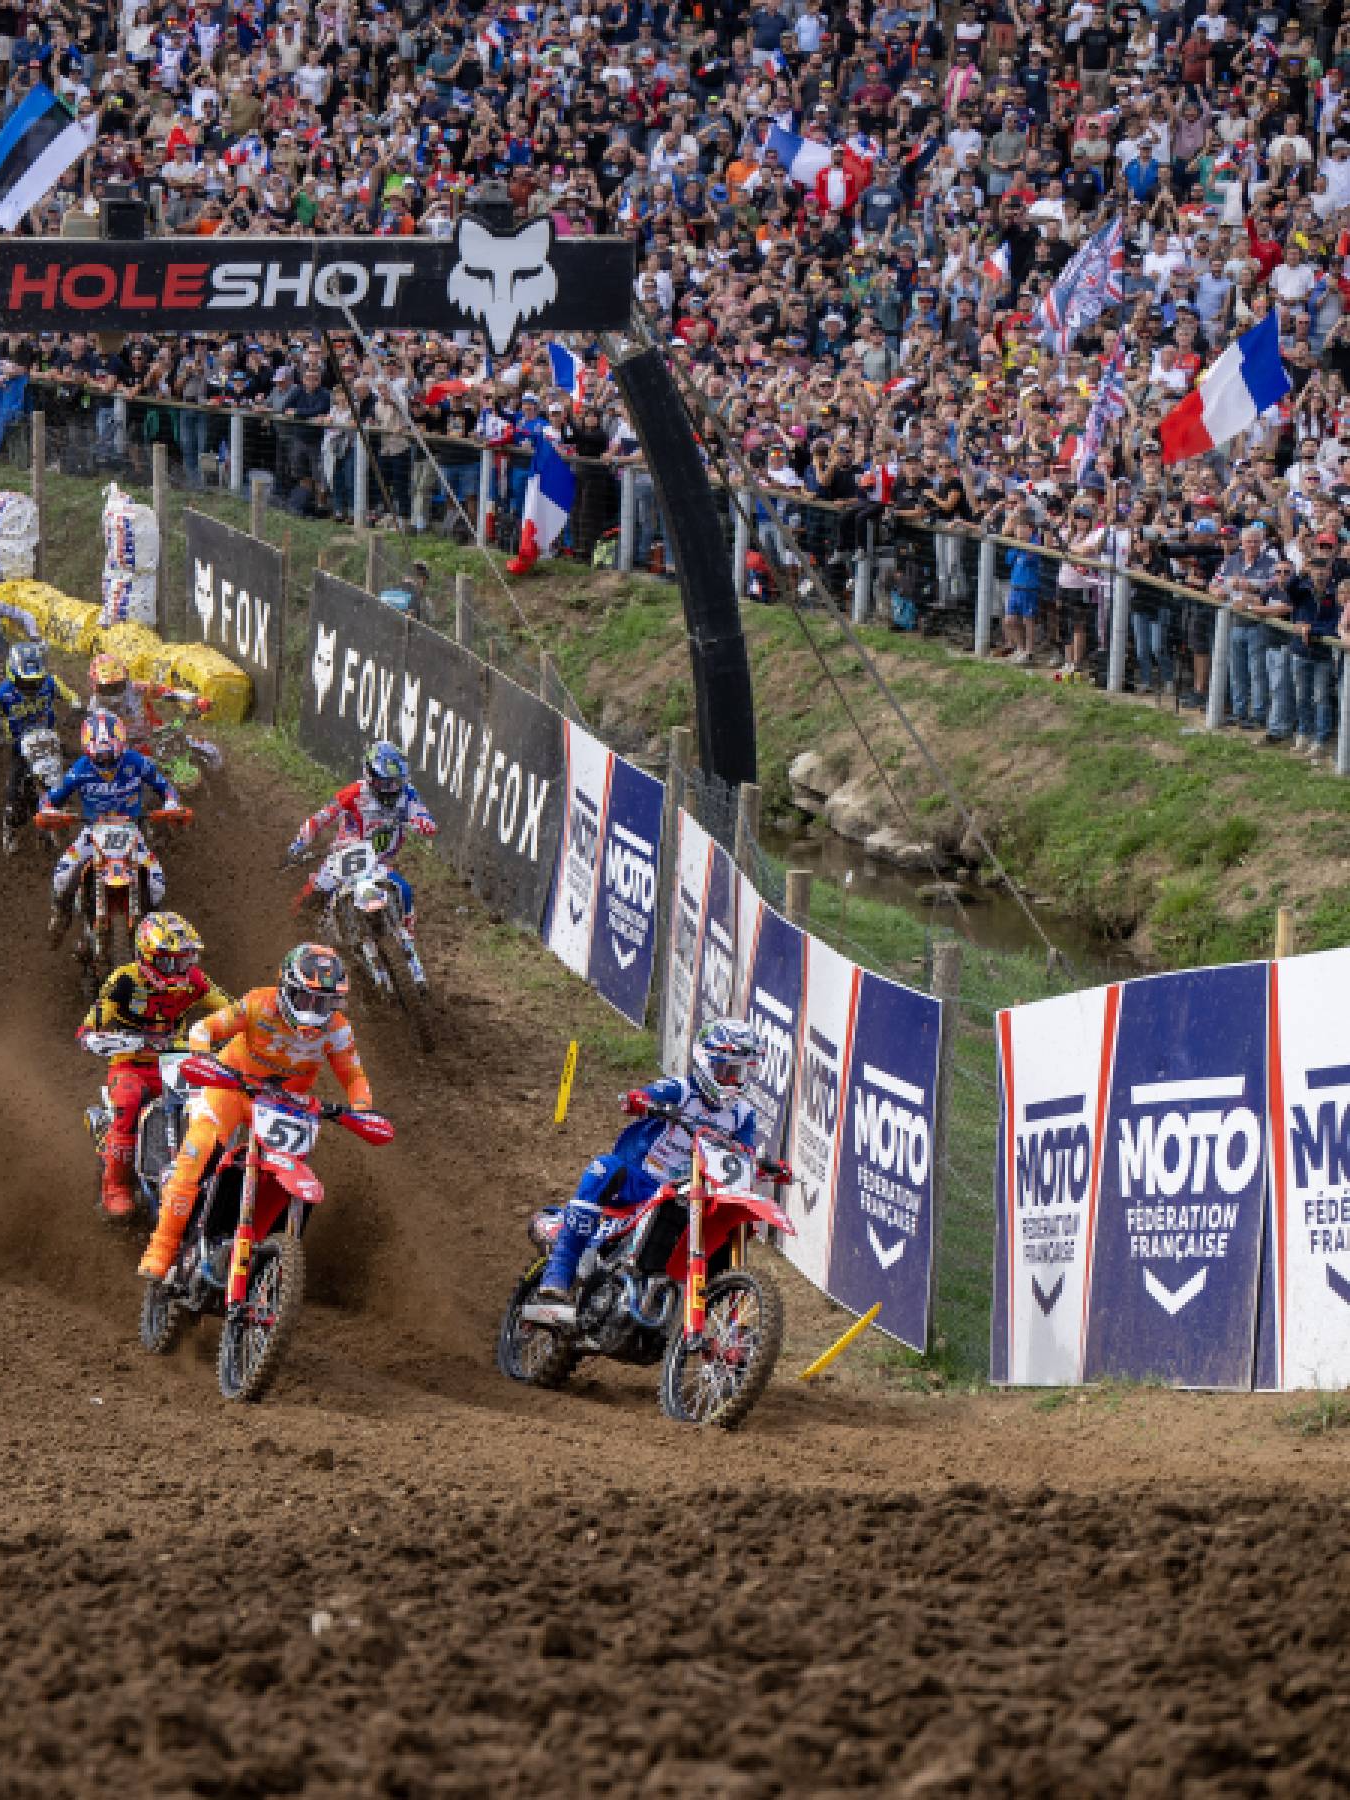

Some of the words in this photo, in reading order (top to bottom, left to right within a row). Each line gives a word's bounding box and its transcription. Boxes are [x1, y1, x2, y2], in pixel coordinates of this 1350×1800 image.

[8, 262, 414, 310] HOLESHOT
[221, 579, 270, 669] FOX
[338, 648, 394, 741] FOX
[420, 698, 473, 800] FOX
[481, 748, 550, 861] FOX
[338, 847, 366, 876] 6
[606, 840, 655, 913] MOTO
[263, 1118, 307, 1153] 57
[720, 1154, 743, 1186] 9
[854, 1086, 929, 1186] MOTO
[1016, 1122, 1091, 1208] MOTO
[1118, 1106, 1262, 1198] MOTO
[1126, 1197, 1240, 1232] FÉDÉRATION
[1131, 1232, 1230, 1263] FRANÇAISE
